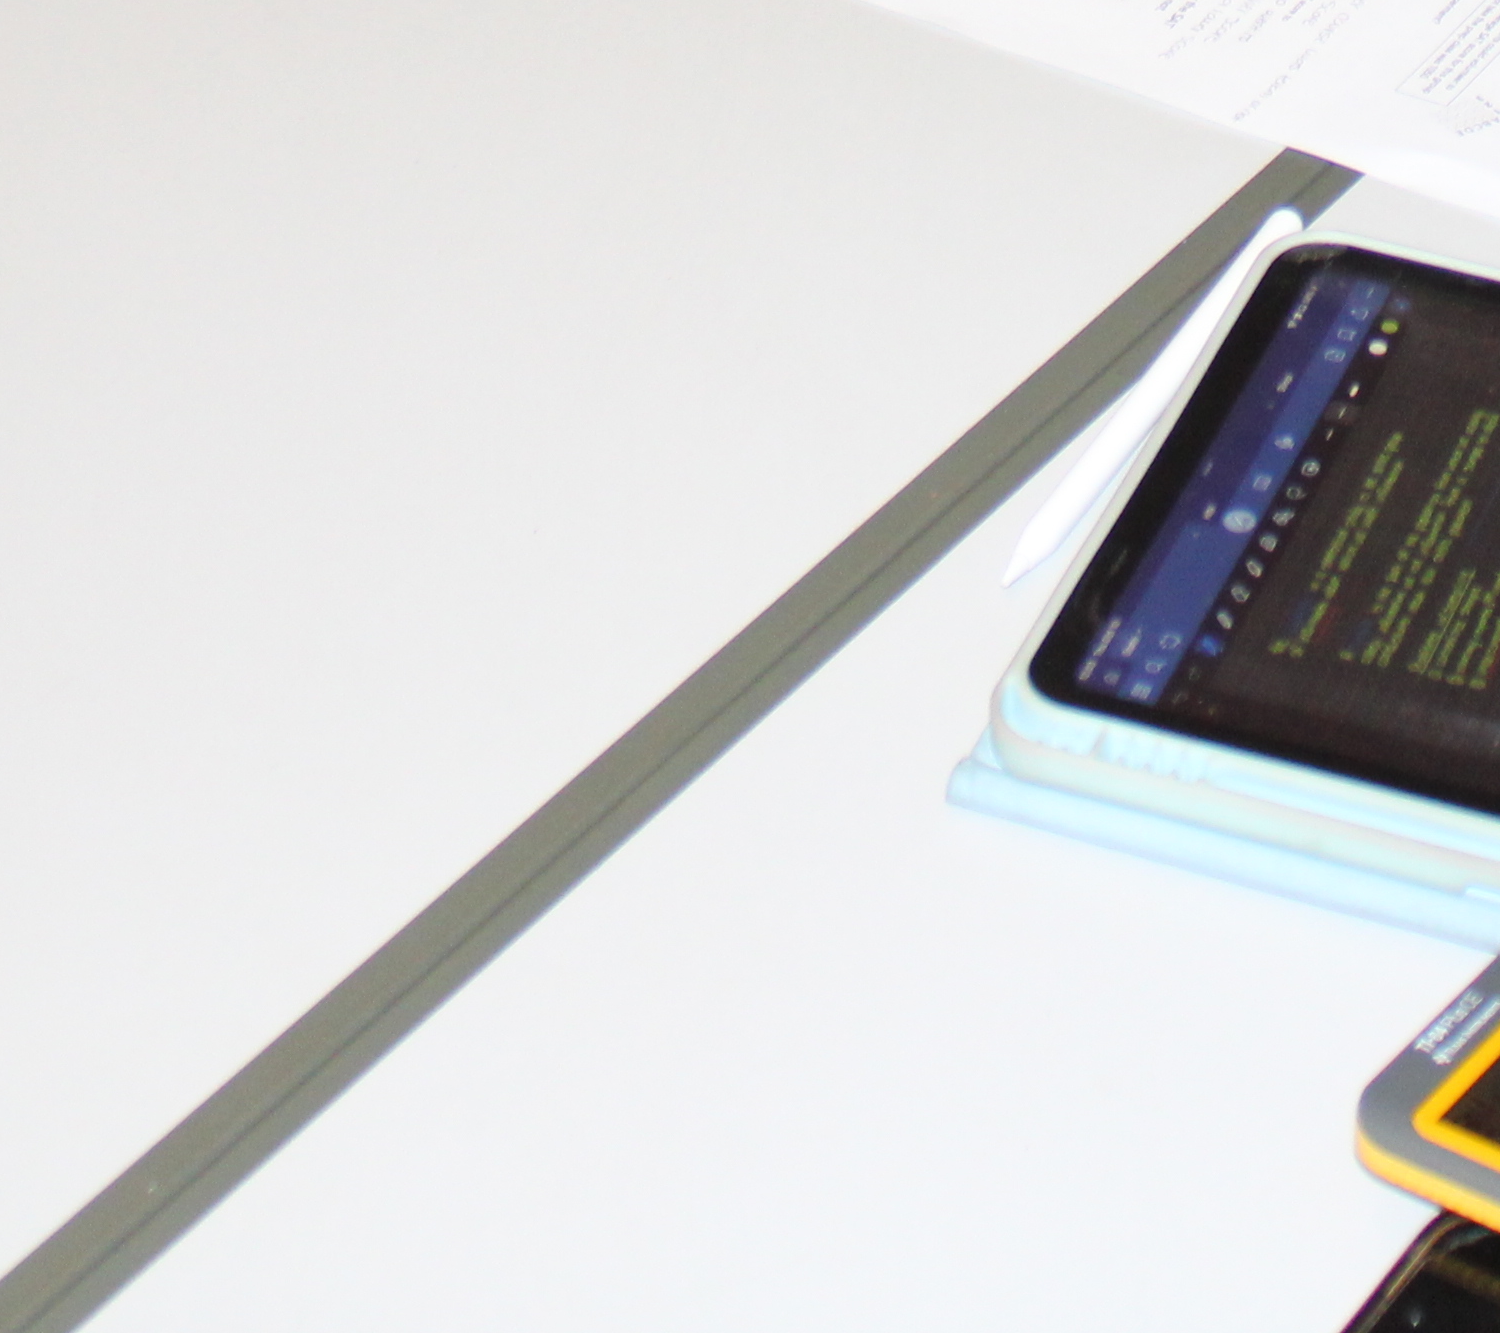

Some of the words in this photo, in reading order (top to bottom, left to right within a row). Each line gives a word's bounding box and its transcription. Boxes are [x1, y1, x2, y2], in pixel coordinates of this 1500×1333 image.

[1177, 0, 1196, 13] the
[1165, 11, 1184, 29] SAT
[1413, 1024, 1450, 1054] TI-84
[1439, 1008, 1469, 1031] Plus
[1459, 989, 1484, 1012] CE
